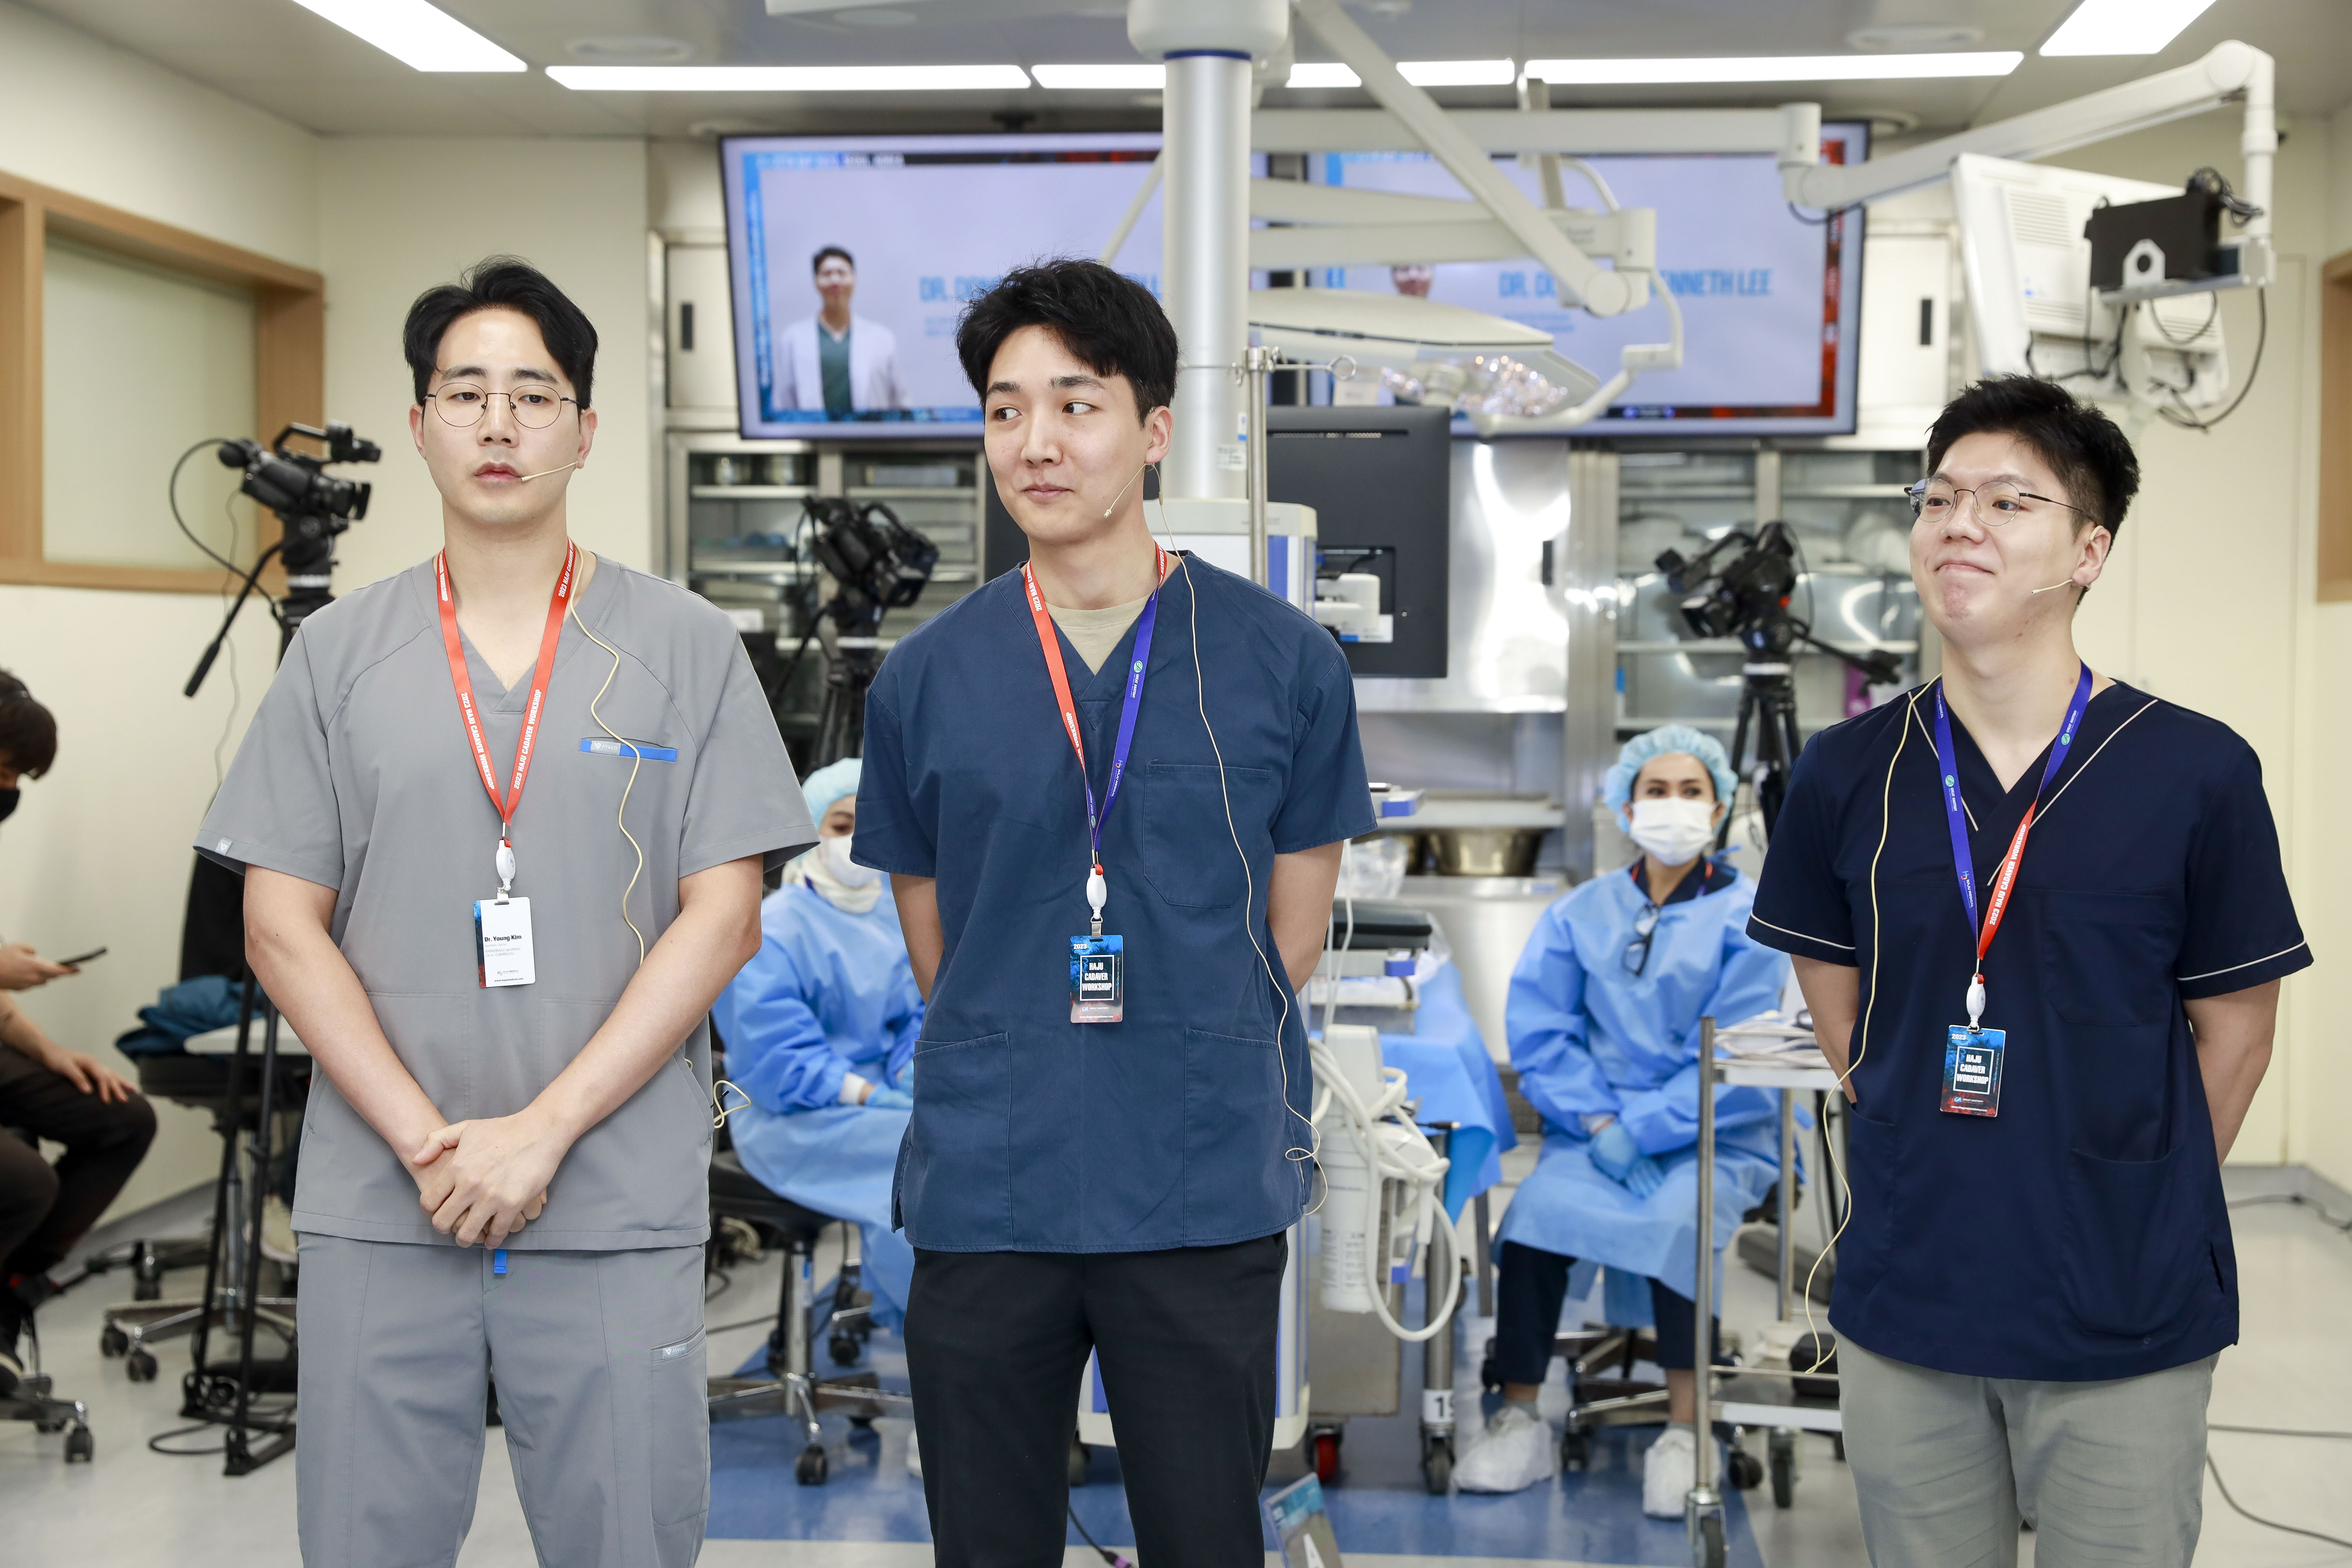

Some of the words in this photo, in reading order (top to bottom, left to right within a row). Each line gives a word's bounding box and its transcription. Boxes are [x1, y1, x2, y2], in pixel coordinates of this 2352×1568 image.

[1738, 268, 1773, 296] LEE
[559, 583, 567, 598] 2023
[1029, 582, 1037, 596] HAJU
[1033, 596, 1043, 611] 2023
[461, 692, 470, 708] 2023
[531, 689, 542, 725] WORKSHOP
[466, 709, 476, 724] HAJU
[1066, 712, 1079, 748] WORKSHOP
[470, 725, 484, 753] CADAVER
[522, 725, 533, 754] CADAVER
[479, 753, 495, 789] WORKSHOP
[518, 755, 527, 772] HAJU
[514, 772, 522, 789] 2023
[1989, 908, 2000, 925] 2023
[1995, 891, 2005, 908] HAJU
[2001, 861, 2016, 890] CADAVER
[2010, 824, 2027, 860] WORKSHOP
[1089, 962, 1104, 971] HAJU
[1084, 972, 1108, 981] CADAVER
[1082, 982, 1112, 991] WORKSHOP
[1966, 1054, 1982, 1063] HAJU
[1960, 1064, 1985, 1074] CADAVER
[1957, 1073, 1989, 1085] WORKSHOP
